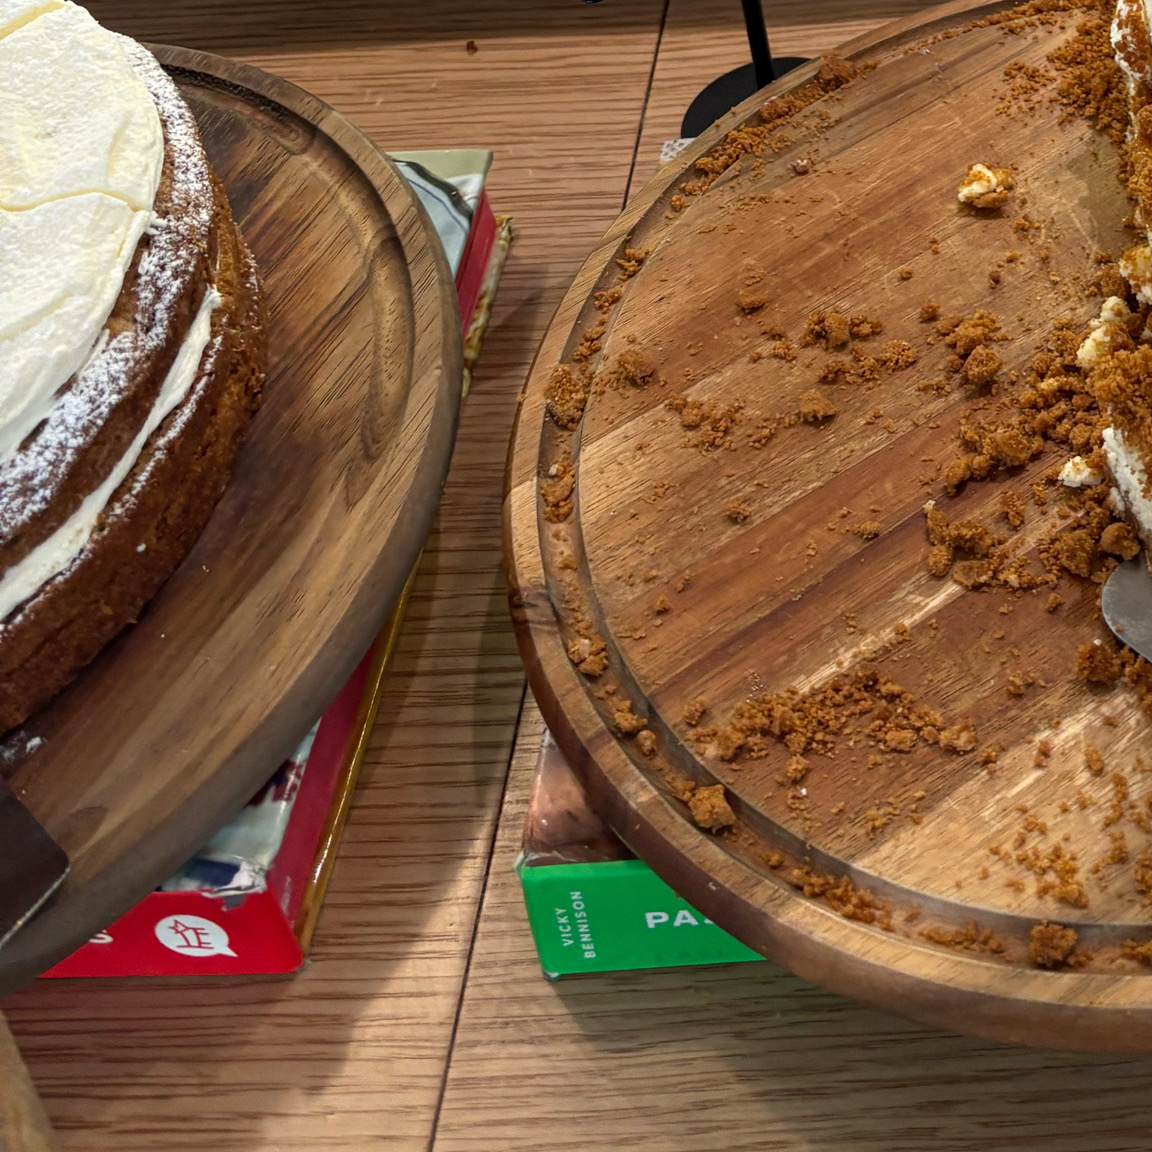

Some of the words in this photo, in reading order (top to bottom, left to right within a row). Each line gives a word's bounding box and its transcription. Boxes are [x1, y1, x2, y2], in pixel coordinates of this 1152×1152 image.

[554, 907, 574, 947] VICKY
[570, 891, 597, 959] BENNISON
[645, 909, 715, 929] PA
